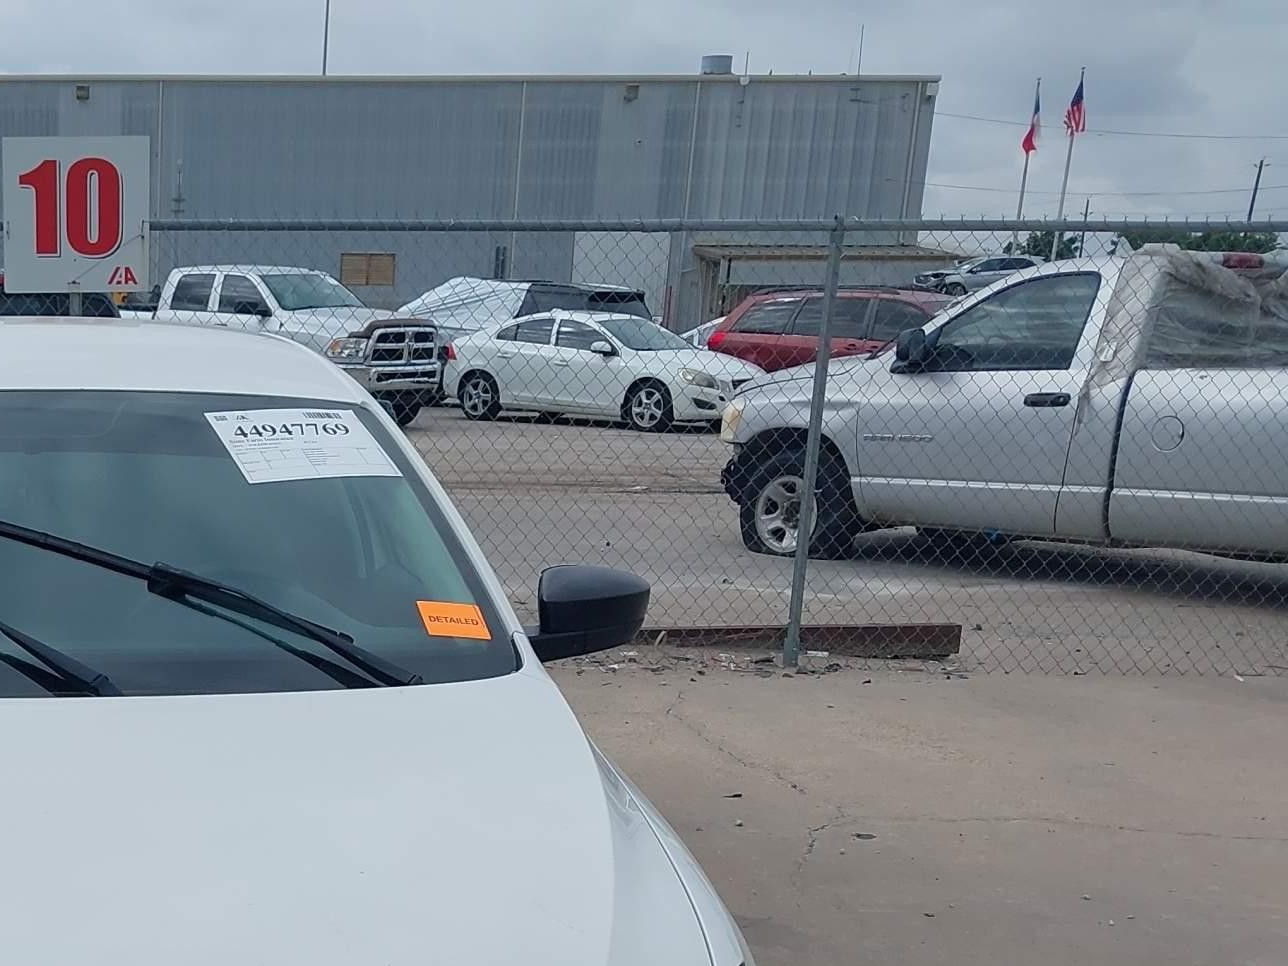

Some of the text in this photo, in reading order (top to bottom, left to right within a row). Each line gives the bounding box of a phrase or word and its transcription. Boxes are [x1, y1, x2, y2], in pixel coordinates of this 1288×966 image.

[18, 157, 124, 260] 10
[234, 423, 350, 438] 44947769
[428, 615, 479, 626] DETAILED
